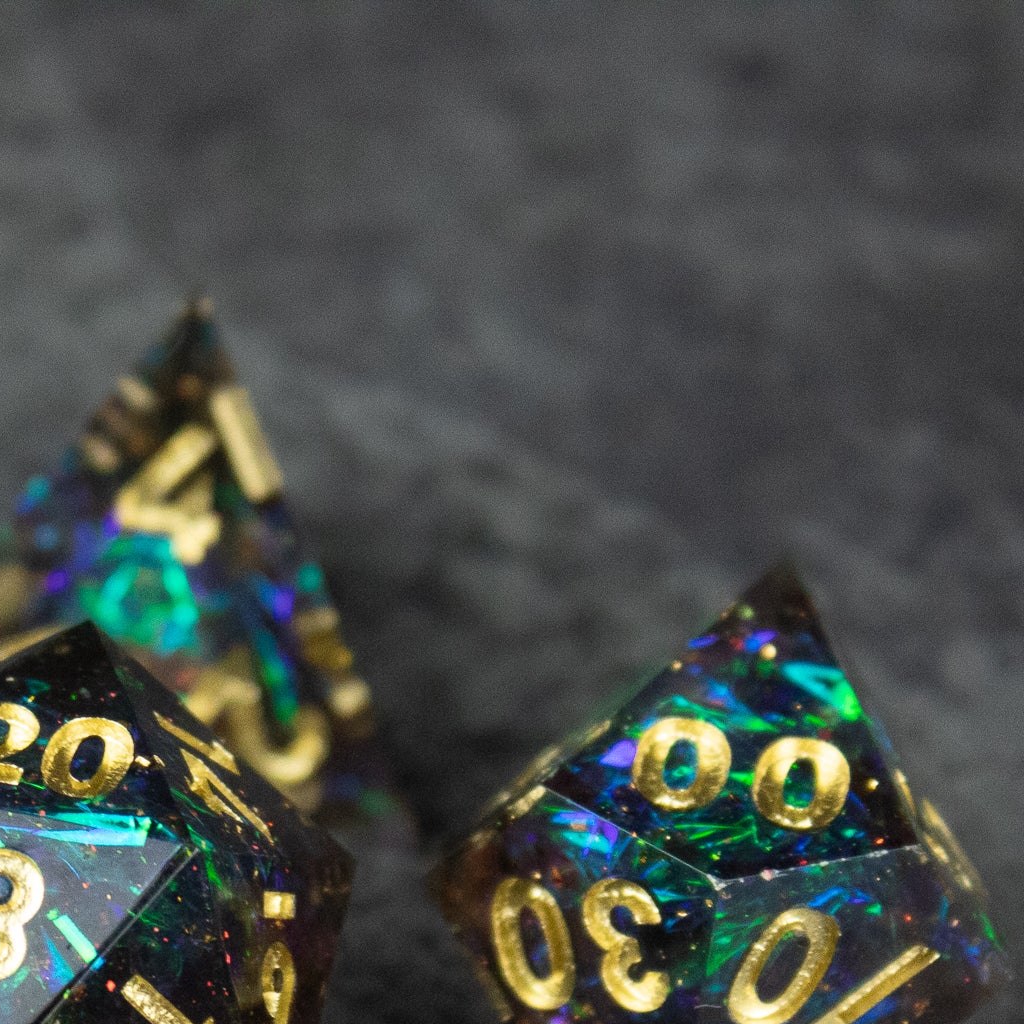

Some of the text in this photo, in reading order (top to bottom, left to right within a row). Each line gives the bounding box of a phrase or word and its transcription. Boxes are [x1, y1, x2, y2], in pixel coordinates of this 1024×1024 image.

[114, 424, 222, 564] 4
[632, 717, 850, 830] 00
[491, 877, 671, 1013] 30
